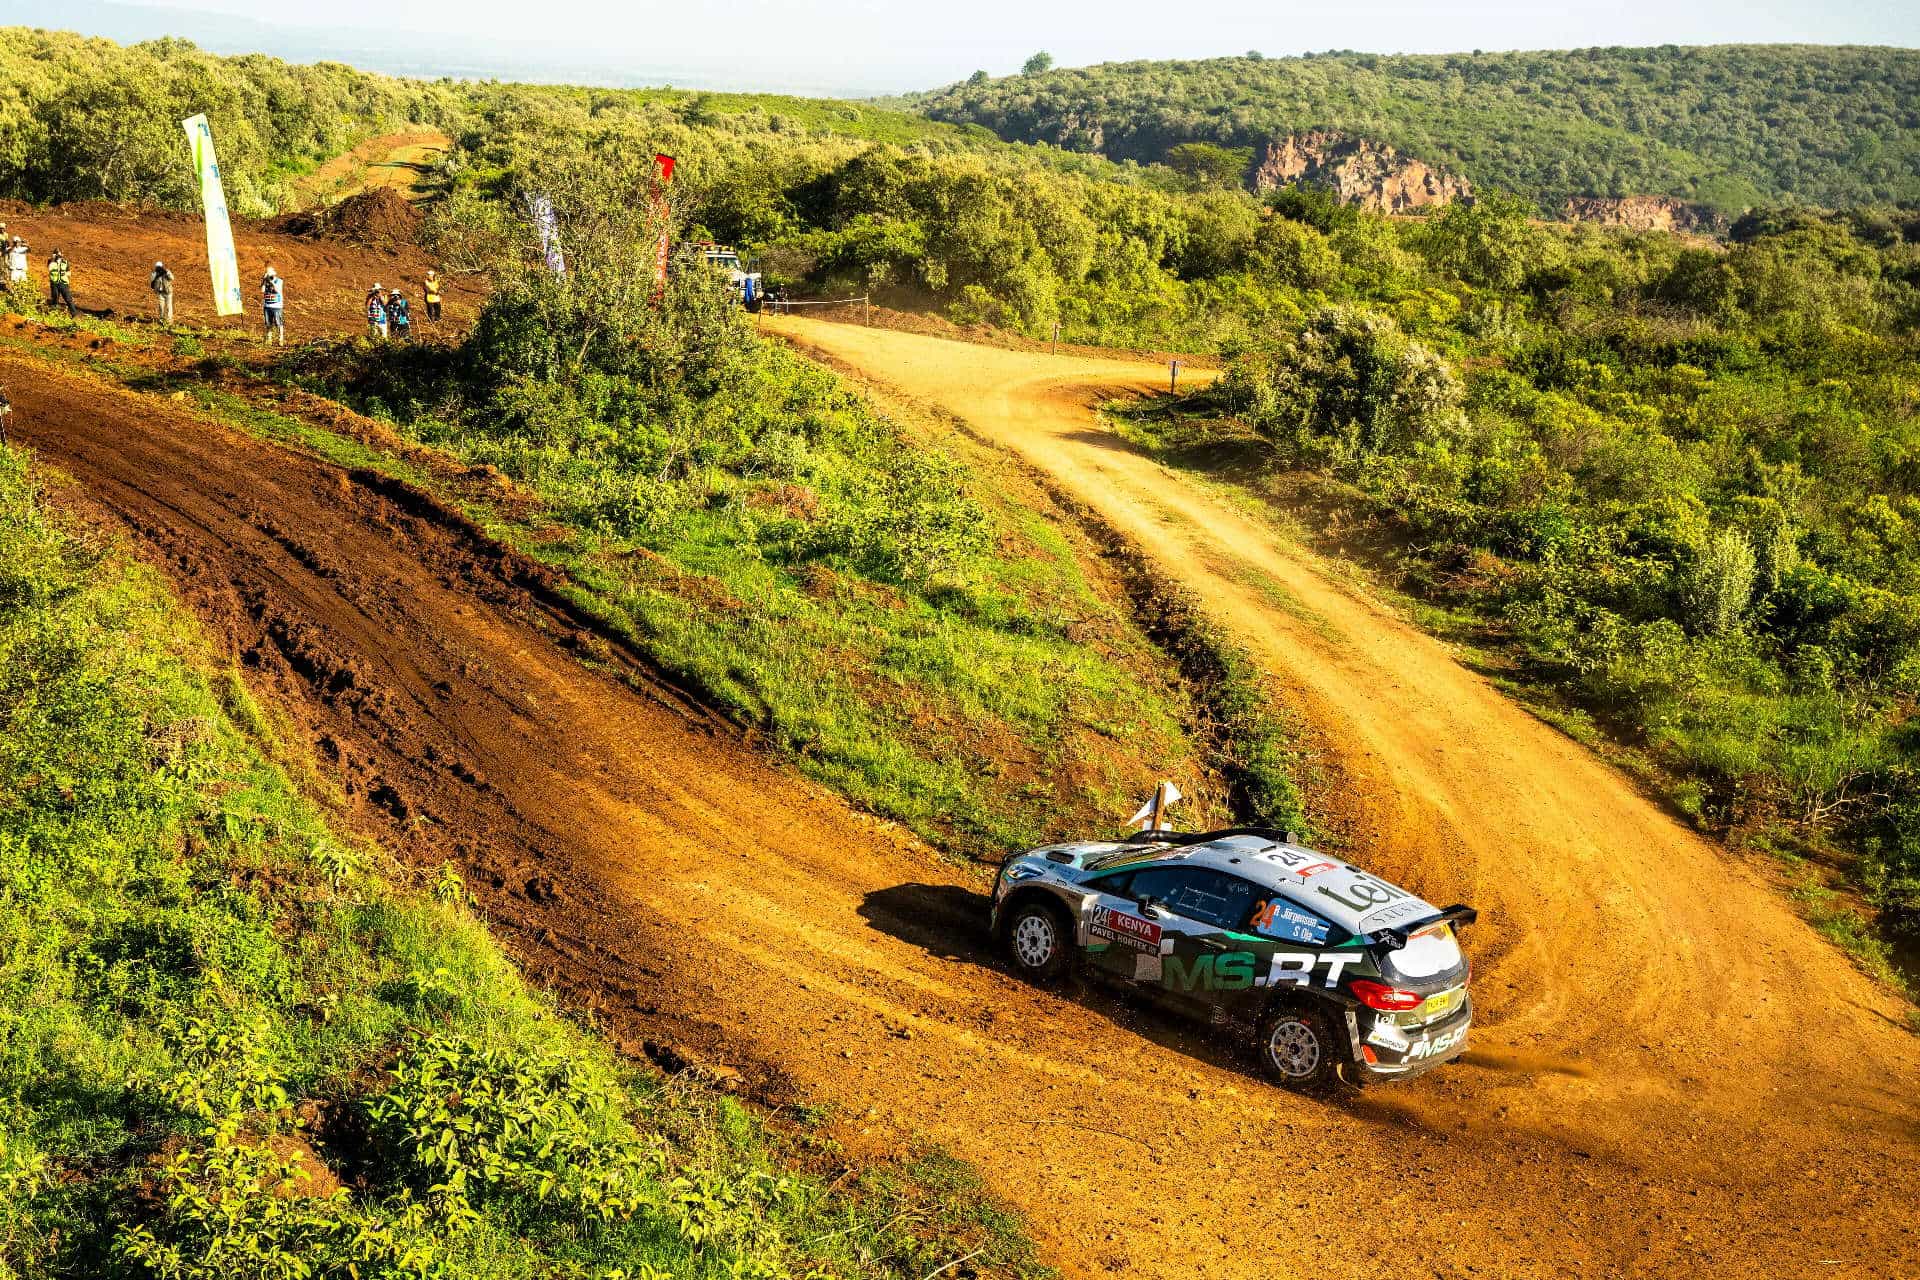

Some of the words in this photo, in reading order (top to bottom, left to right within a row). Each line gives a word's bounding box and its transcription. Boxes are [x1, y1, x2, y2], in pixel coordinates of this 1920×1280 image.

[1267, 851, 1309, 866] 24
[1094, 905, 1108, 926] 24
[1249, 900, 1276, 928] 24
[1091, 926, 1115, 940] PAVEL
[1117, 914, 1152, 936] KENYA
[1292, 926, 1300, 937] S
